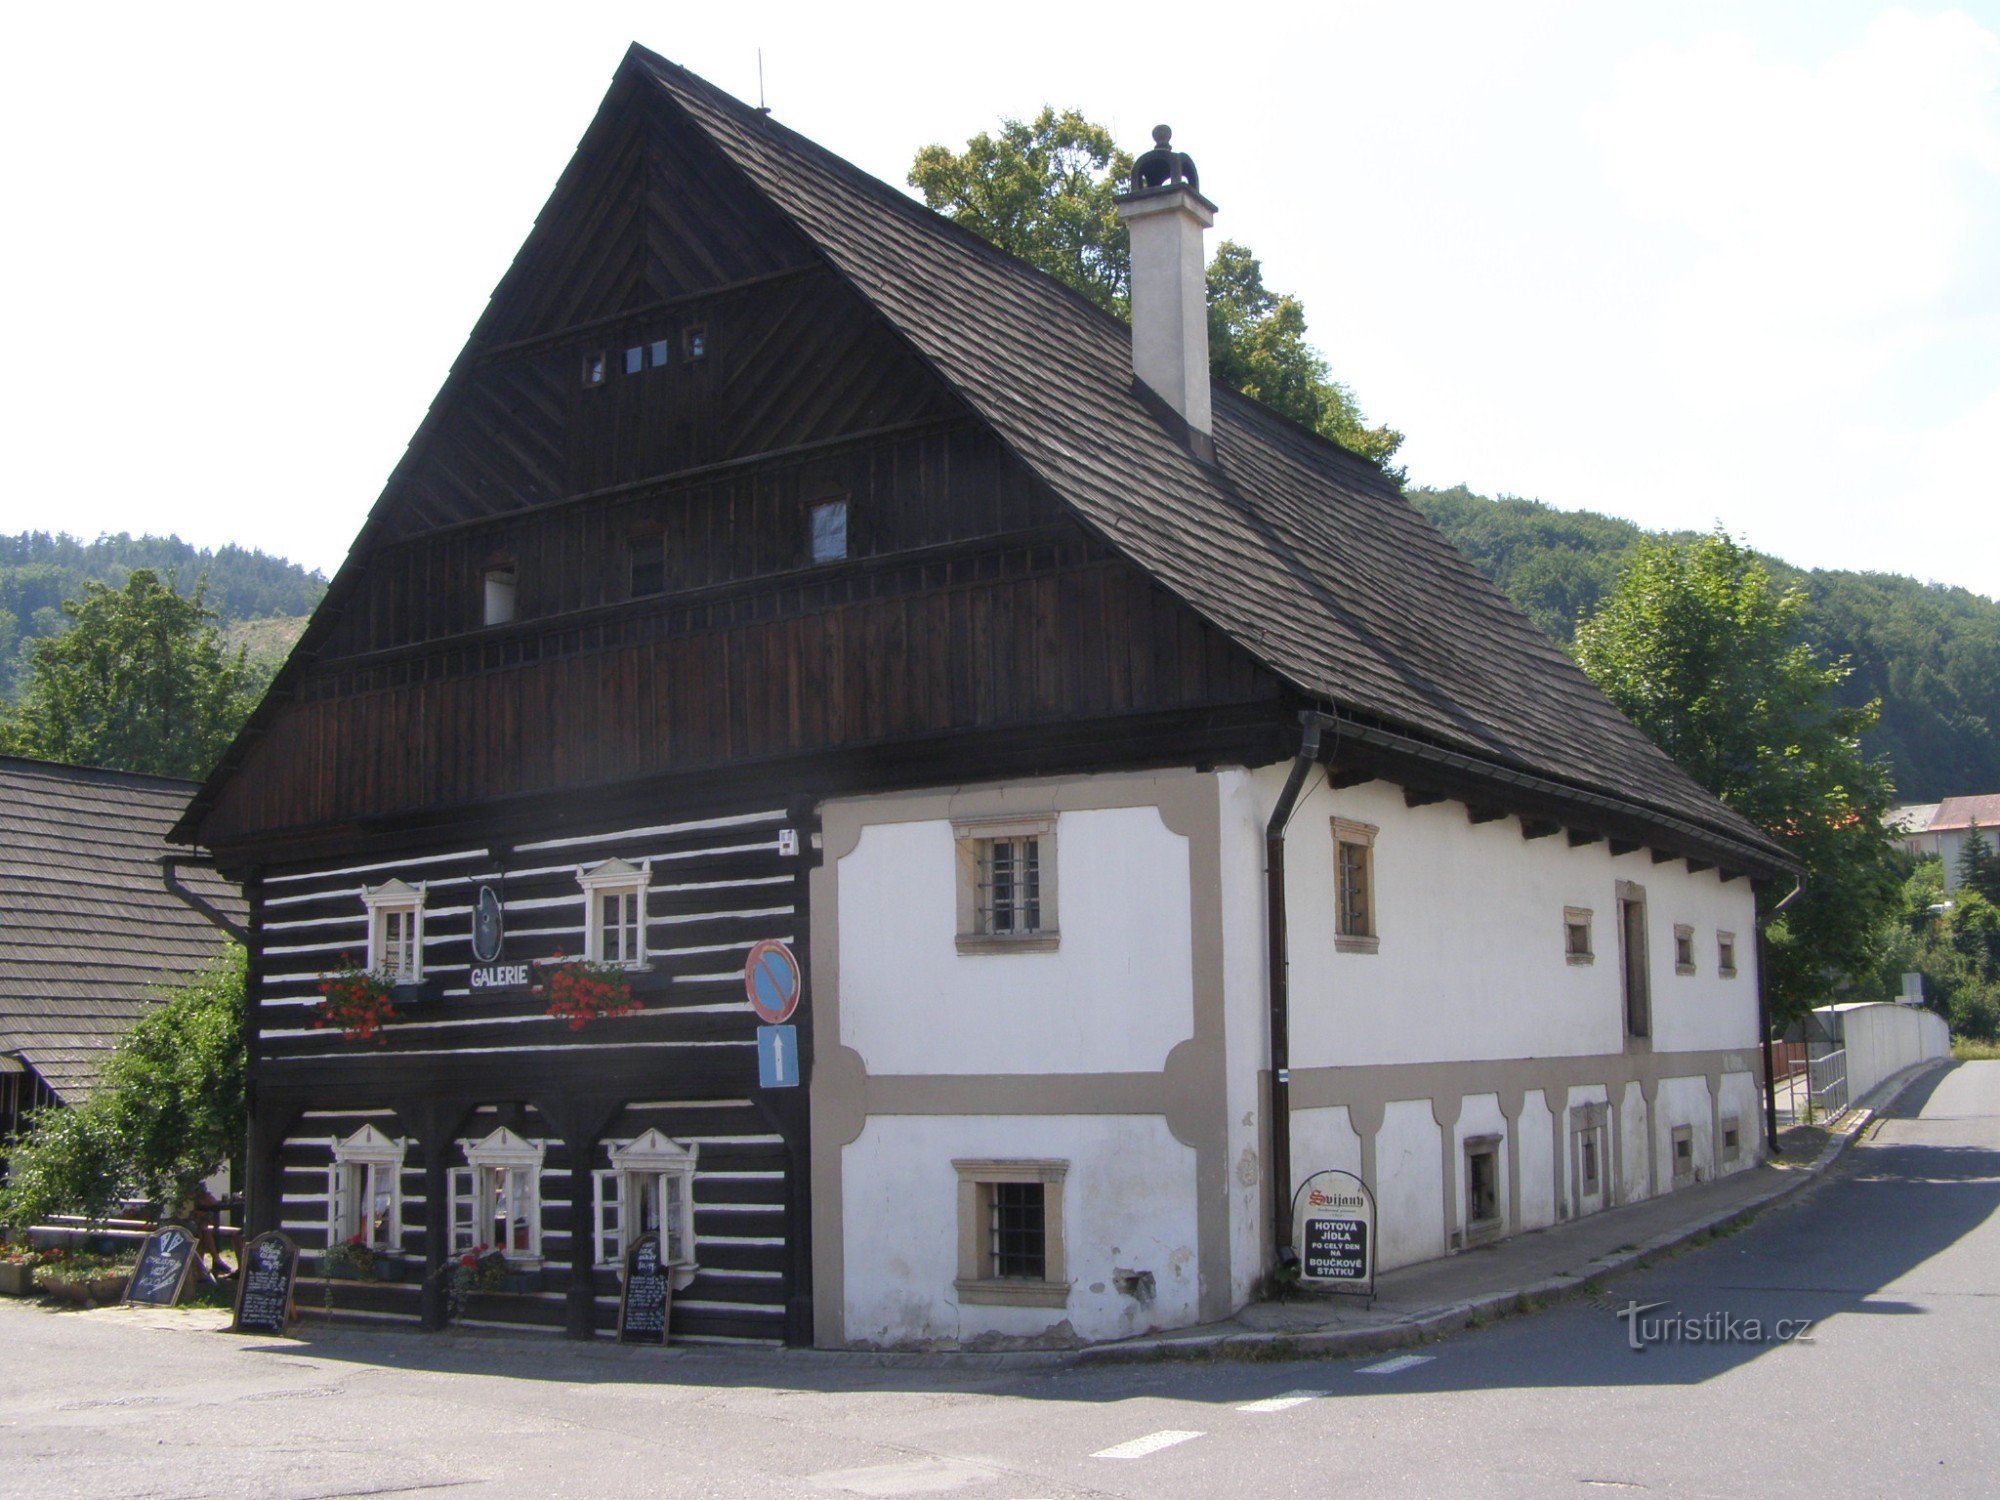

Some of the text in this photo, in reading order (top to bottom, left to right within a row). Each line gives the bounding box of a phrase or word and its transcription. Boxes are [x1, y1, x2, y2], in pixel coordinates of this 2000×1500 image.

[471, 965, 528, 987] GALERIE
[1309, 1190, 1364, 1207] Svijany
[1321, 1231, 1351, 1241] JÍDLA
[1310, 1258, 1362, 1267] BOUČKOVÉ
[1317, 1267, 1354, 1276] STATKU
